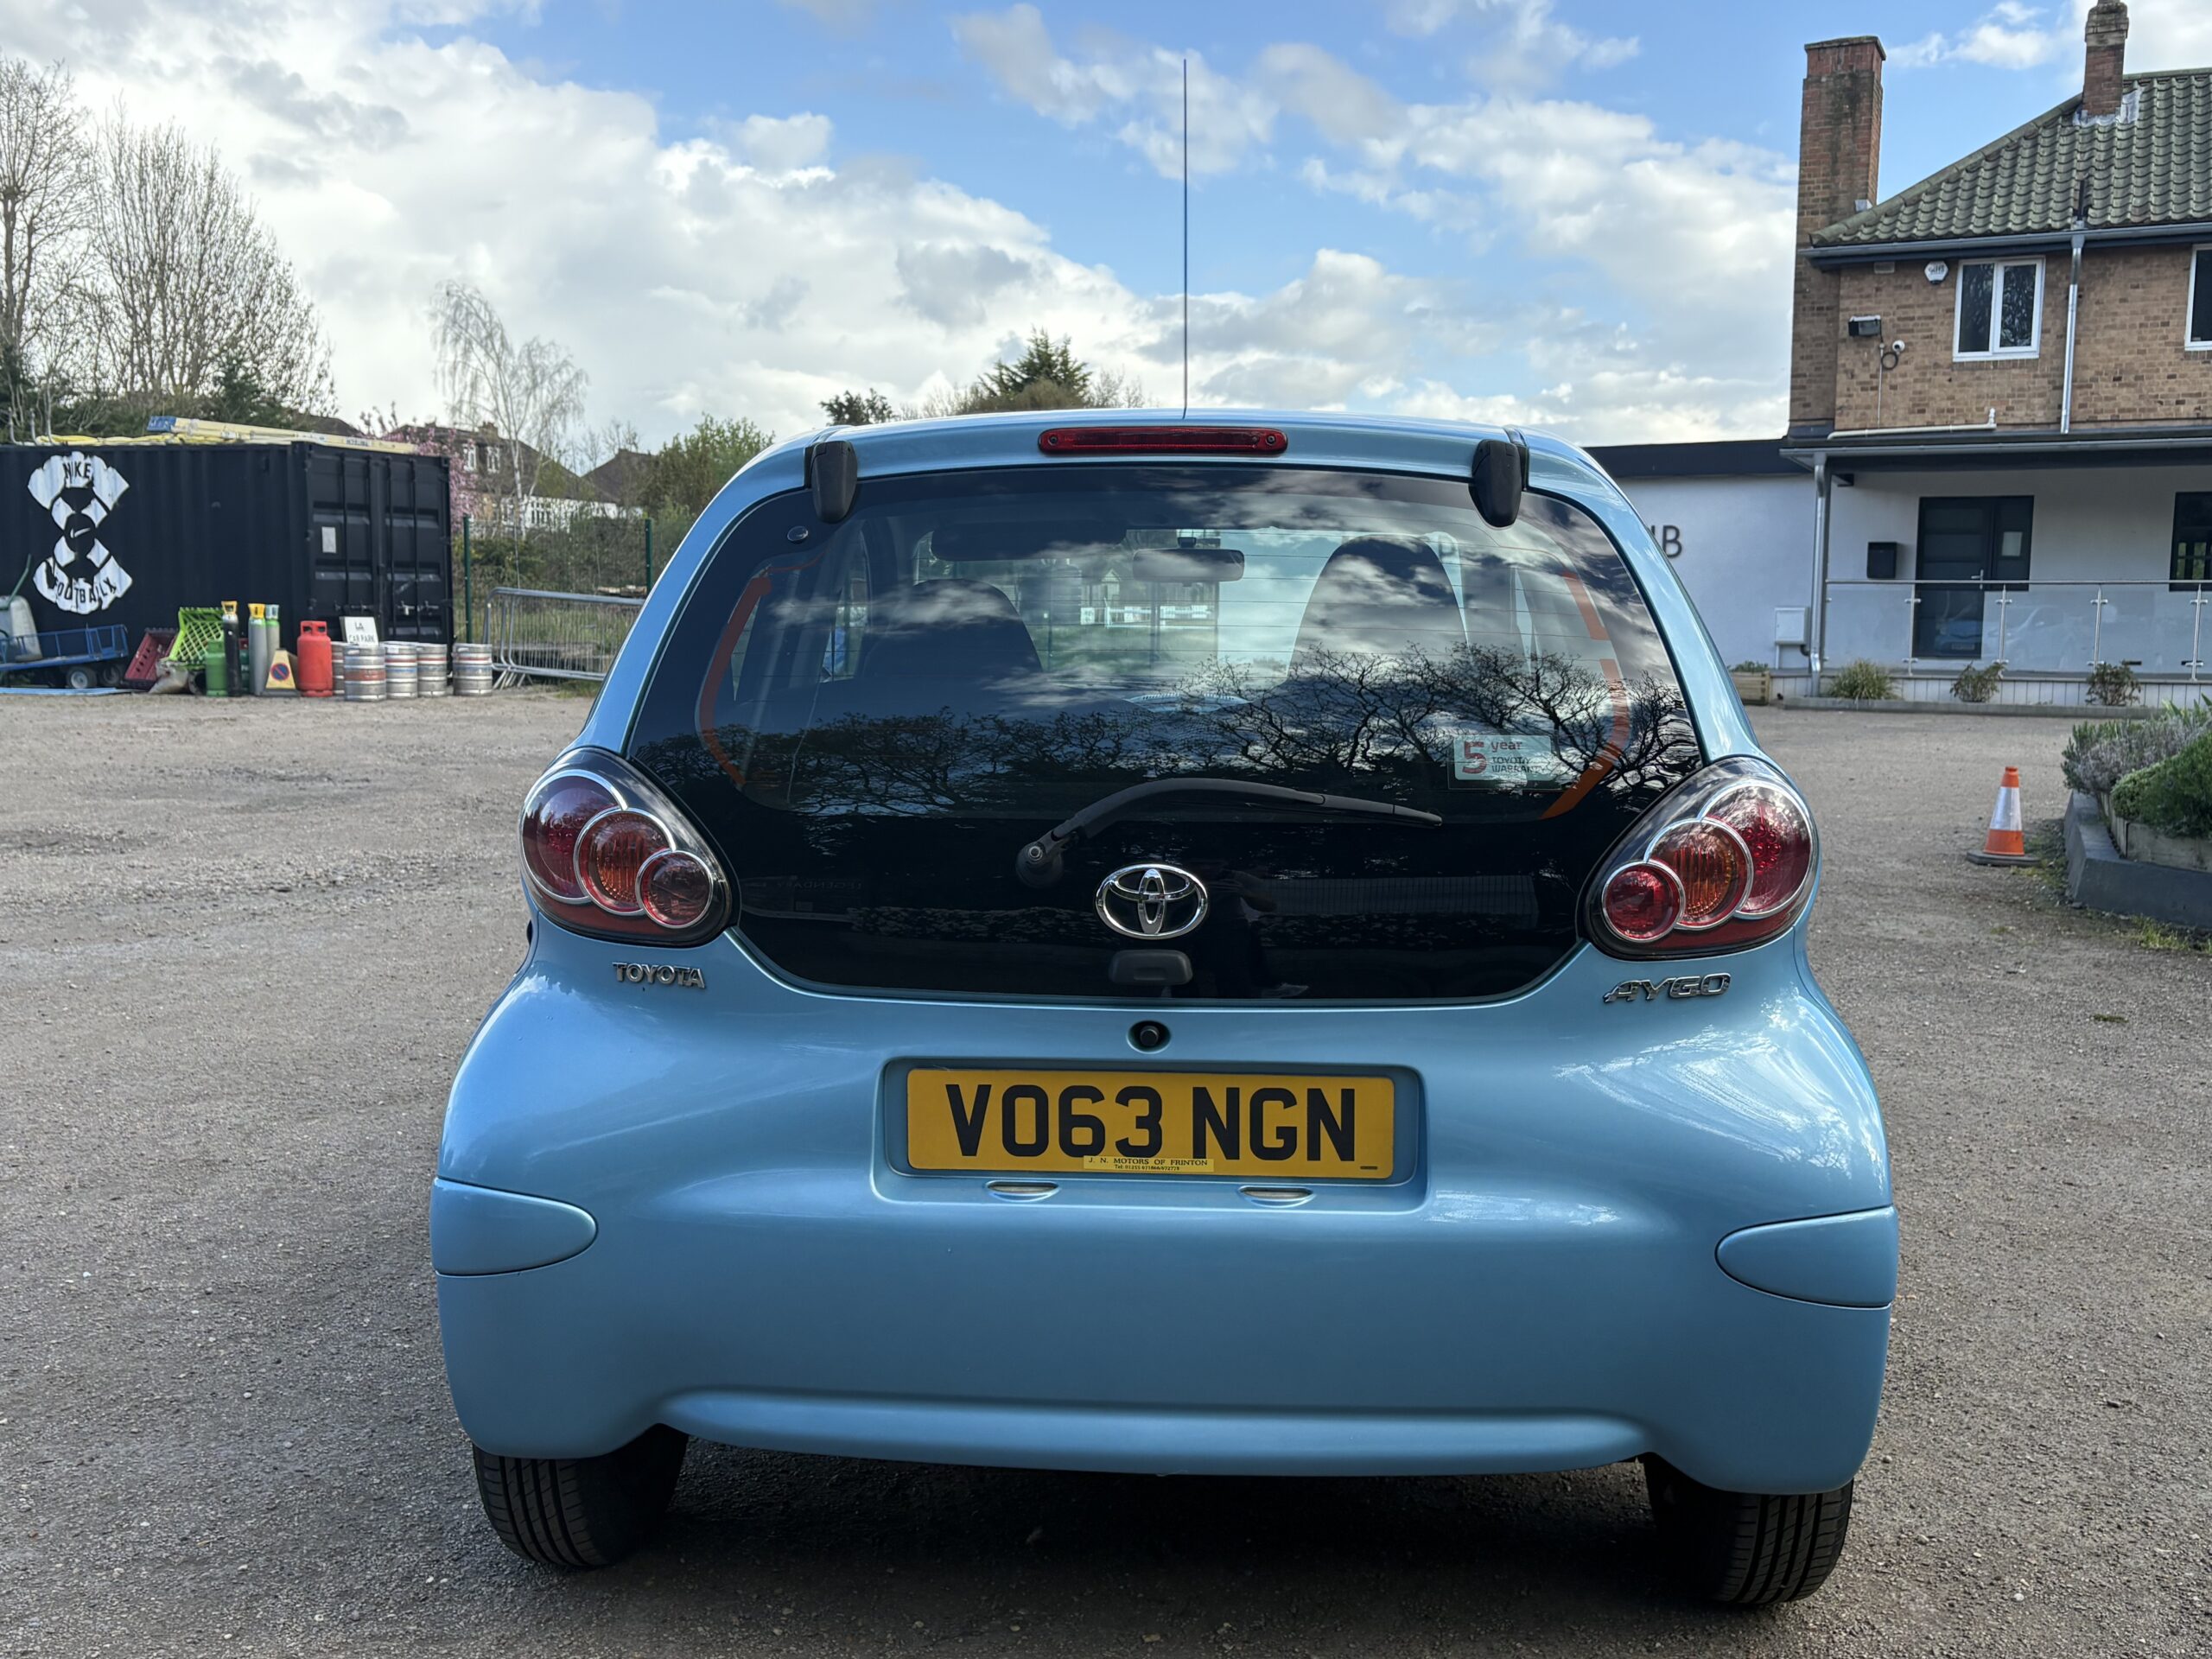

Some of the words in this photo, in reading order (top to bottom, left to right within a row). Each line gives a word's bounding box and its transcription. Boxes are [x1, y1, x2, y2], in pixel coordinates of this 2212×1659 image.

[63, 461, 92, 480] NIKE
[1650, 524, 1683, 559] B
[1462, 741, 1487, 774] 5
[1491, 741, 1522, 753] year
[612, 962, 706, 989] TOYOTA
[1603, 972, 1732, 1003] AYGO
[945, 1084, 1163, 1159] VO63
[1192, 1087, 1355, 1161] NGN
